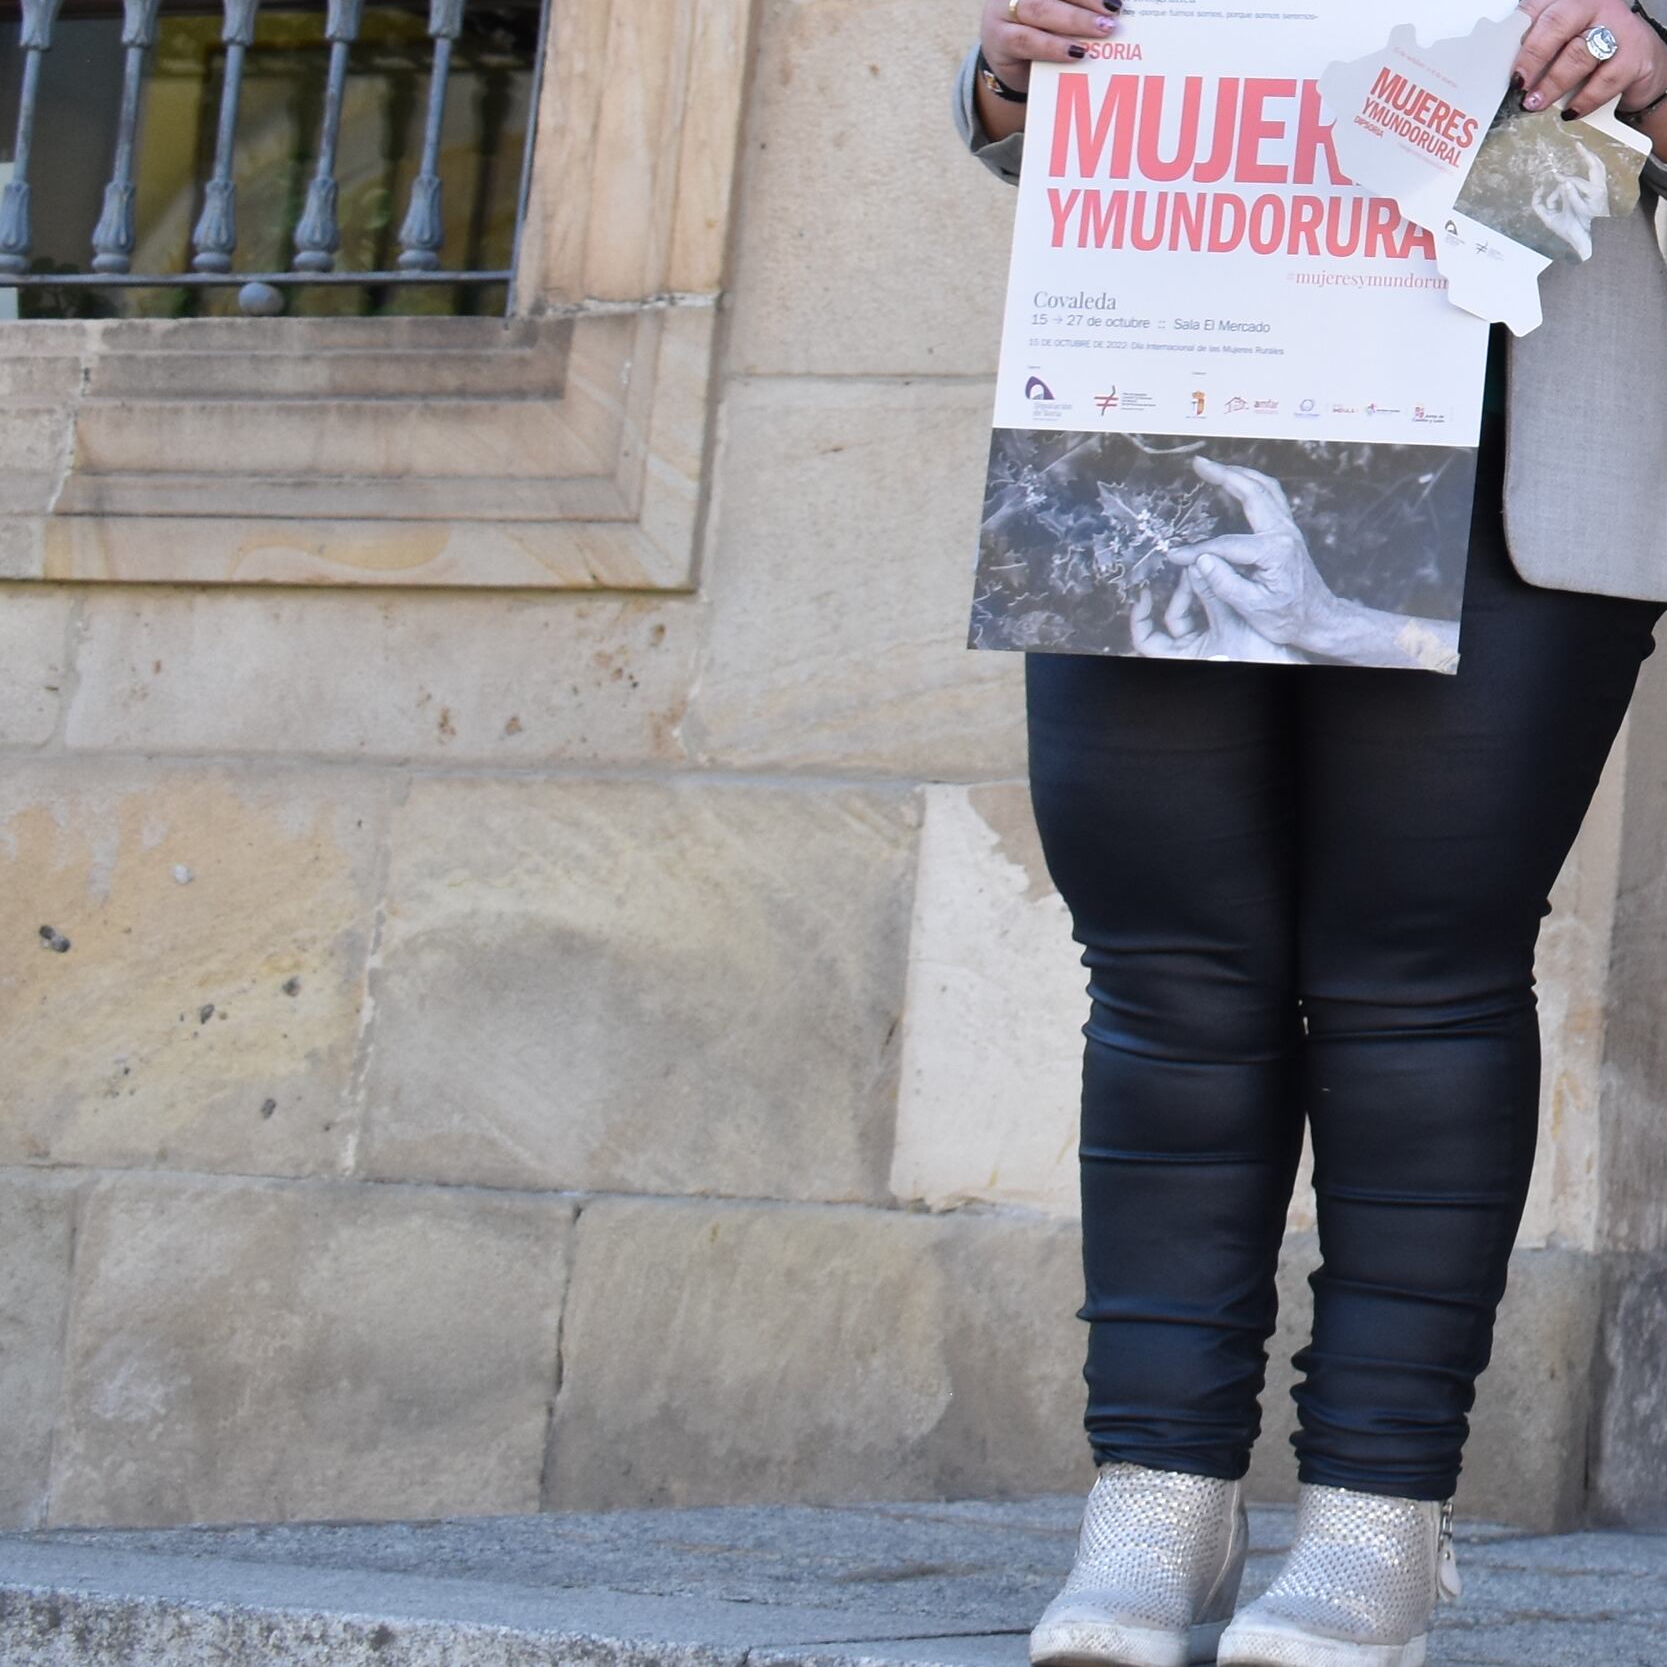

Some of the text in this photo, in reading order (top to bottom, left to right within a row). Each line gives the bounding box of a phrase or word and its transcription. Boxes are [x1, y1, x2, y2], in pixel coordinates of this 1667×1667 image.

[1080, 42, 1142, 60] PSORIA
[1370, 66, 1479, 149] MUJERES
[1049, 73, 1353, 186] MUJER
[1362, 97, 1462, 168] YMUNDORURAL
[1047, 189, 1437, 260] YMUNDORURA
[1285, 270, 1448, 290] #mujeresymundorur
[1033, 291, 1117, 310] Covaleda
[1031, 313, 1048, 325] 15
[1067, 314, 1084, 326] 27
[1087, 315, 1102, 327] de
[1105, 316, 1150, 328] octubre
[1174, 318, 1200, 330] Sala
[1204, 319, 1215, 331] El
[1219, 320, 1271, 333] Mercado
[1055, 338, 1090, 348] OCTUBRE
[1146, 342, 1195, 352] Internacional
[1223, 345, 1253, 355] Mujeres
[1255, 346, 1285, 355] Rurales
